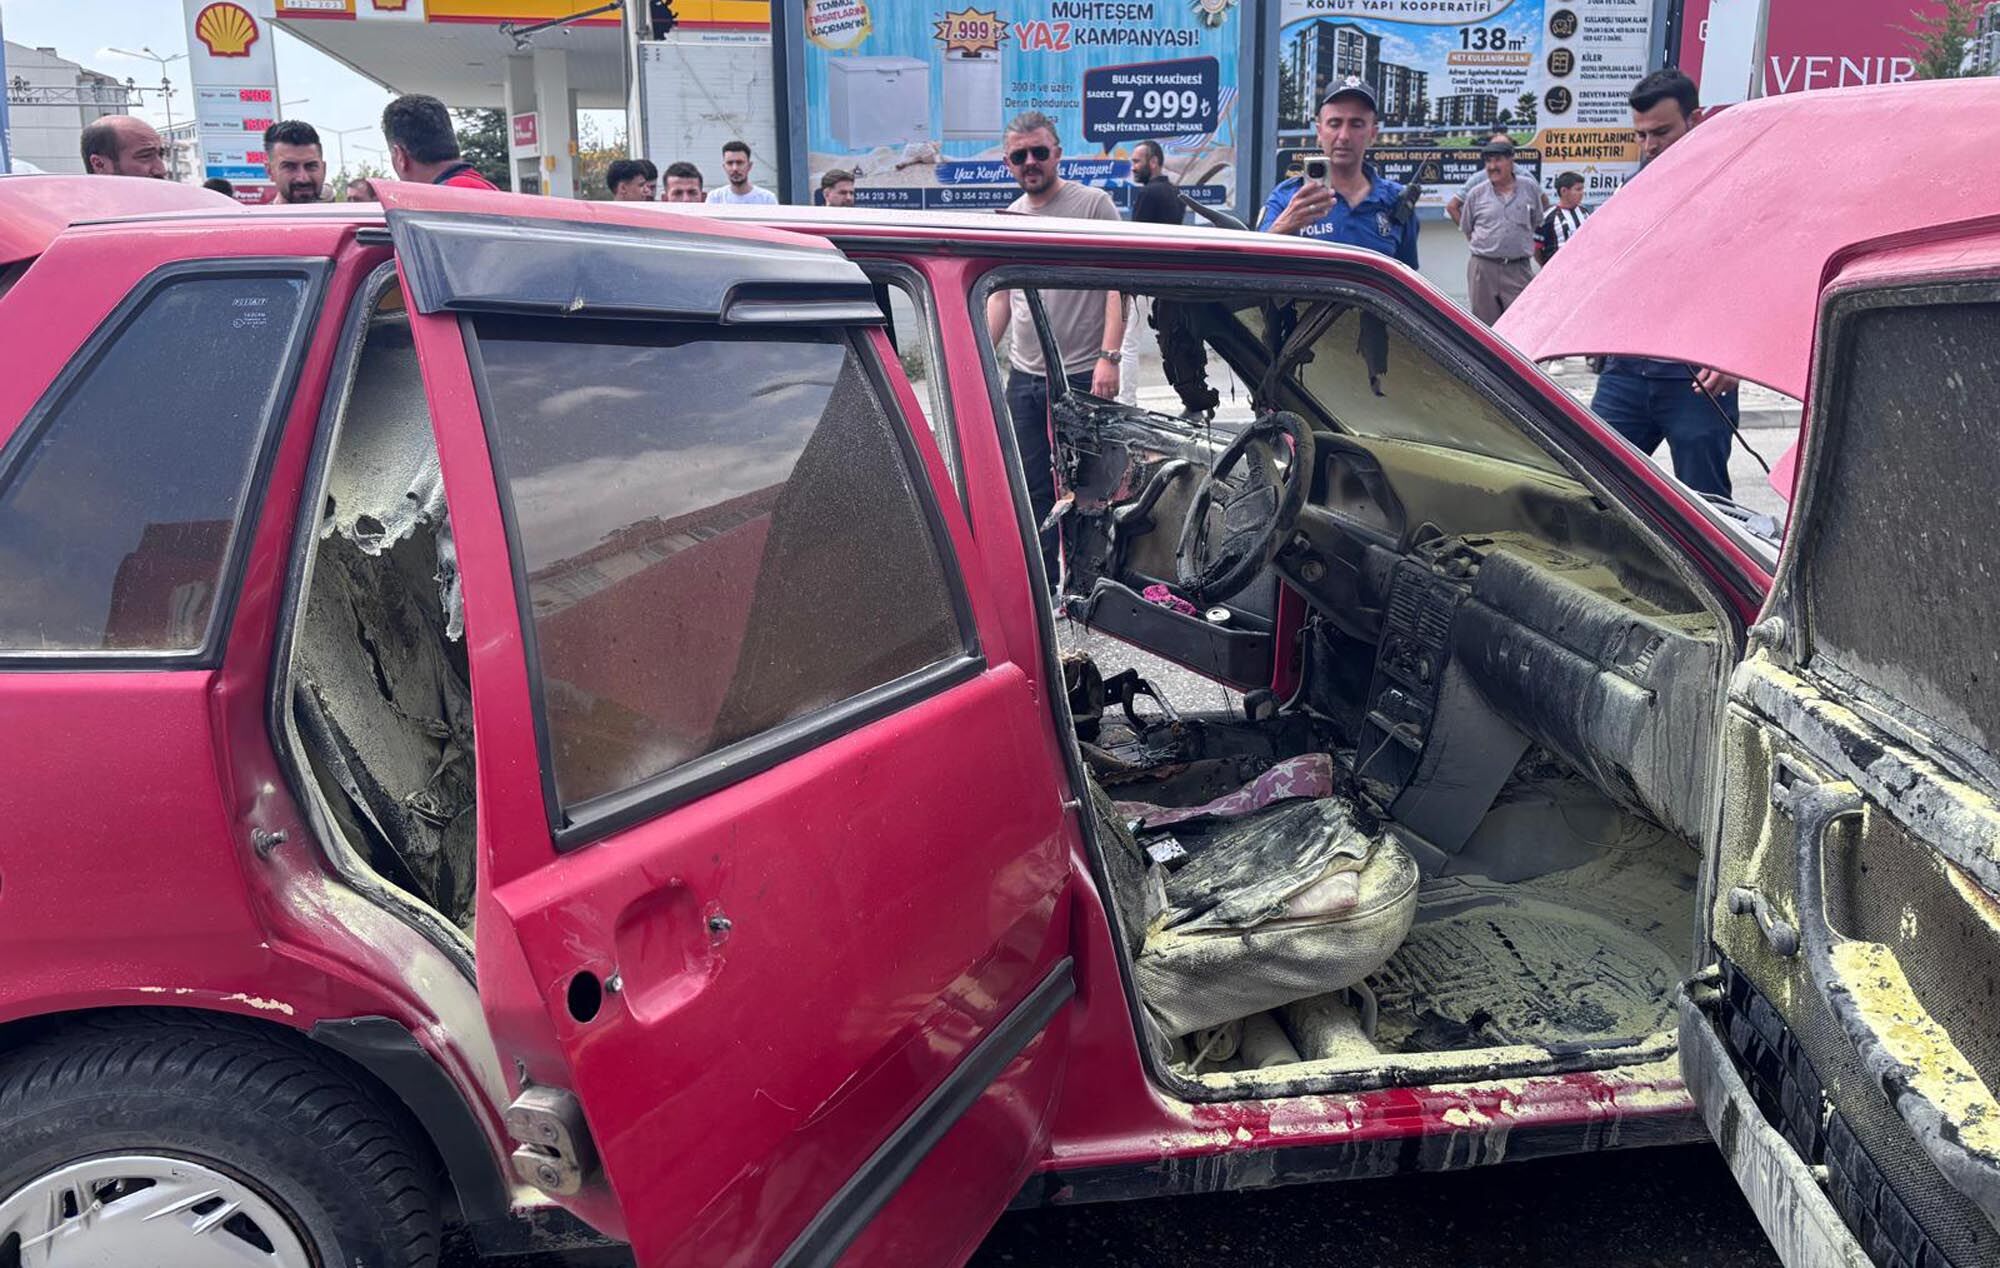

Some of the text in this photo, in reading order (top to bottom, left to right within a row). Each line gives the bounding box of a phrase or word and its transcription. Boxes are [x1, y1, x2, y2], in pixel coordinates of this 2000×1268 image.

[1052, 1, 1153, 24] MUHTEŞEM
[1307, 0, 1353, 9] KONUT
[1363, 0, 1393, 10] YAPI
[944, 21, 989, 39] 7.999
[1015, 21, 1200, 51] YAZ KAMPANYASI!
[1459, 27, 1506, 51] 138
[1581, 52, 1602, 61] KİLER
[1111, 72, 1203, 86] BULAŞIK MAKİNESİ
[1762, 55, 1916, 97] VENIR
[1086, 90, 1115, 99] SADECE
[1116, 90, 1198, 119] 7.999
[1545, 128, 1565, 143] ÜYE
[1545, 145, 1625, 159] BAŞLAMIŞTIR!
[872, 192, 886, 200] 212
